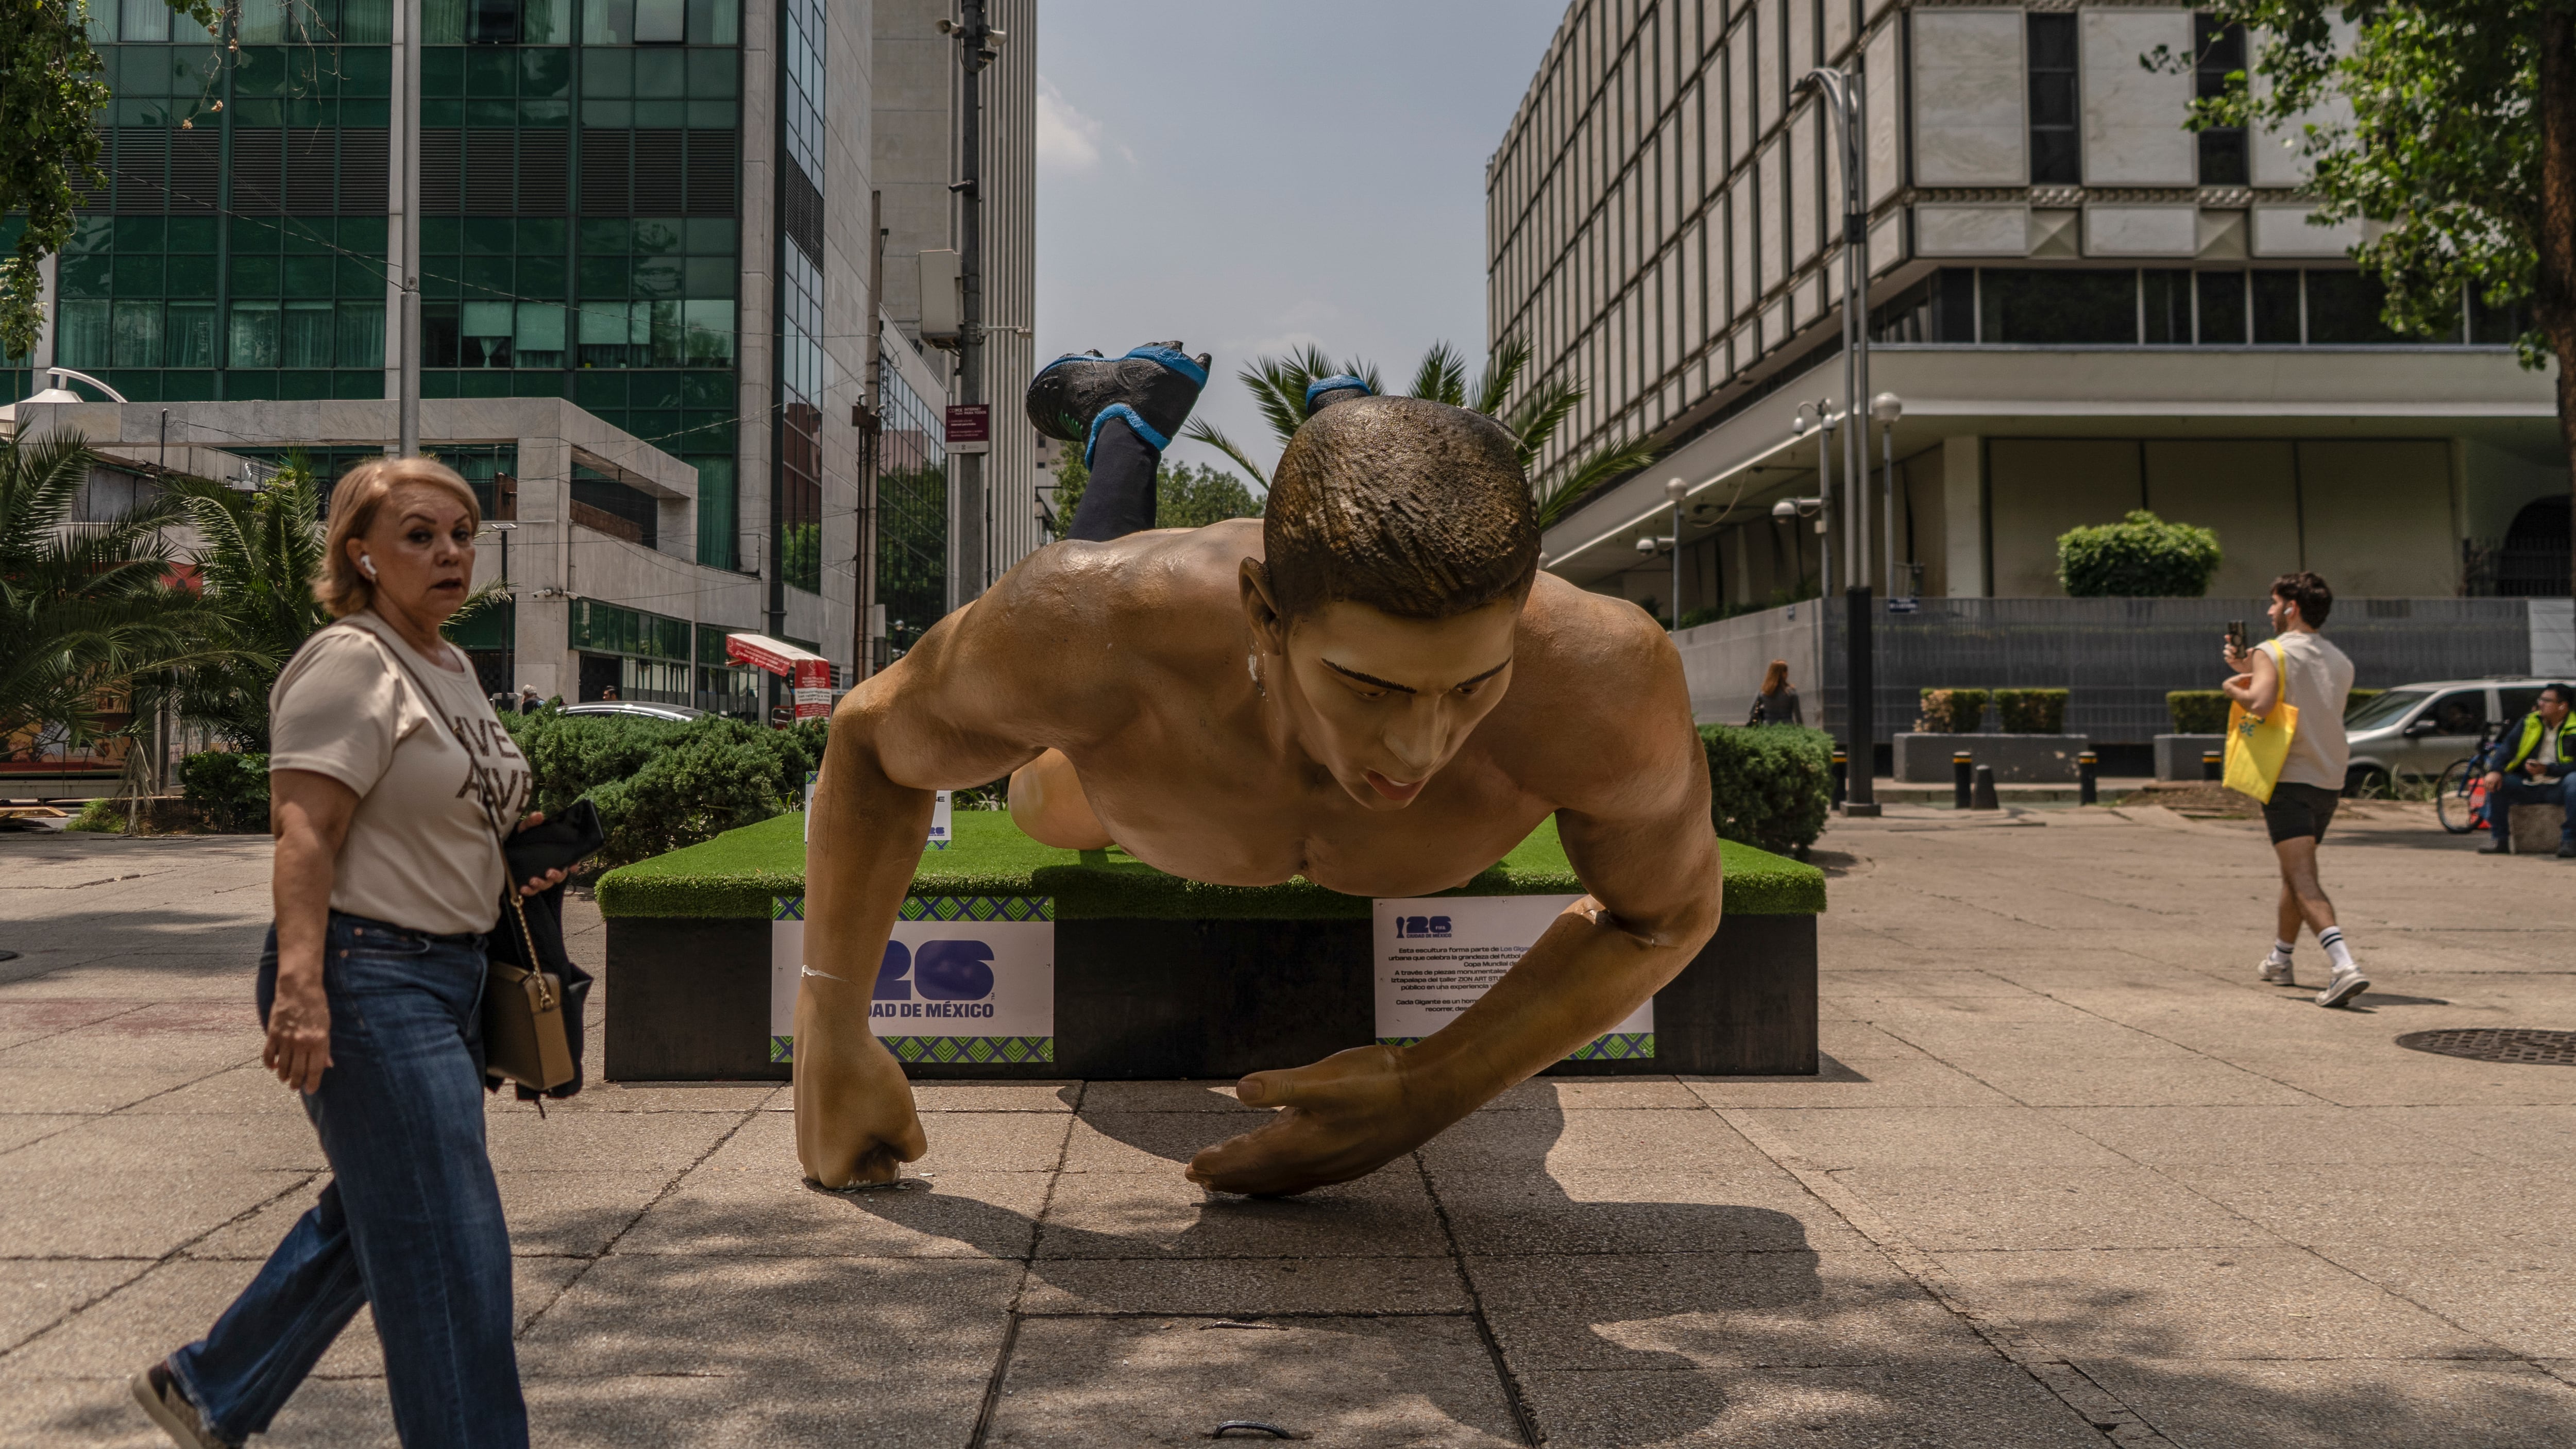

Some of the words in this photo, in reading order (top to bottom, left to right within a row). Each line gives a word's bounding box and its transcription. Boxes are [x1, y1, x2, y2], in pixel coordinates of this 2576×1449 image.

[1406, 916, 1451, 933] 26
[901, 1003, 922, 1017] DE
[926, 1001, 994, 1018] MÉXICO
